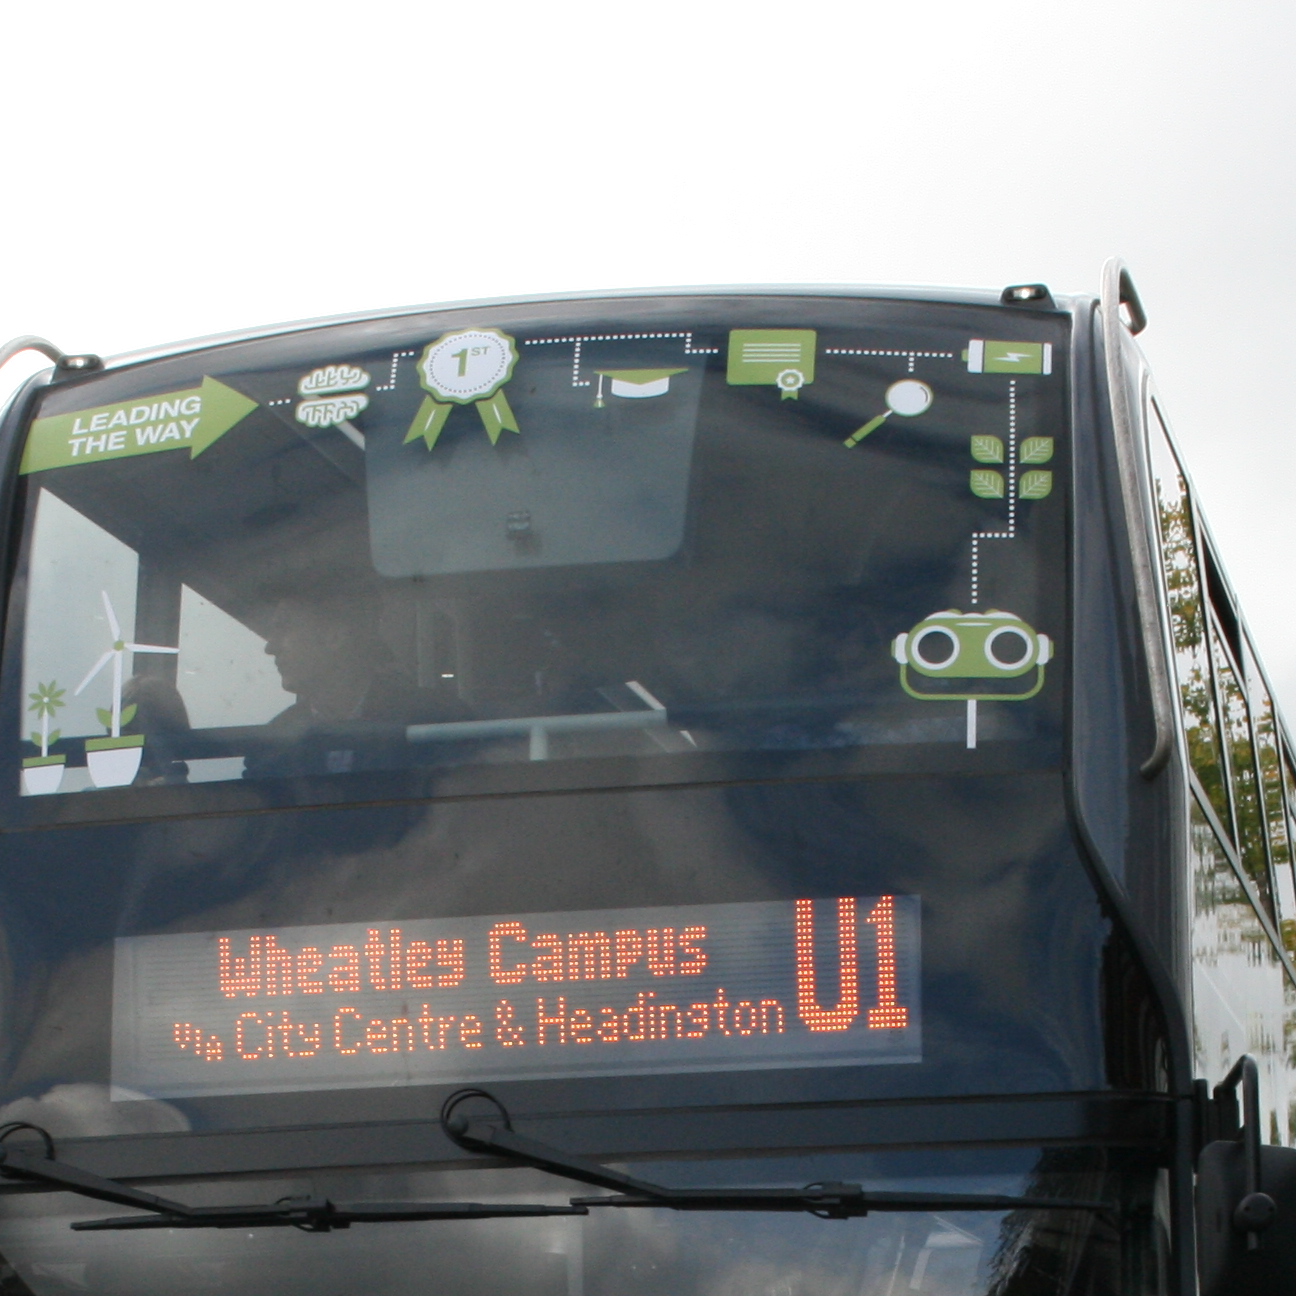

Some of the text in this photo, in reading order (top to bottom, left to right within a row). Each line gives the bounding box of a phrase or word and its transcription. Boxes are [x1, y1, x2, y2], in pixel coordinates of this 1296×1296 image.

[451, 346, 491, 378] 1ST
[68, 418, 200, 457] THE WAY
[72, 396, 202, 436] LEADING
[218, 921, 708, 998] Wheatley Campus
[796, 895, 908, 1033] U1
[235, 1011, 320, 1060] City
[334, 1003, 483, 1055] Centre
[497, 998, 525, 1047] &
